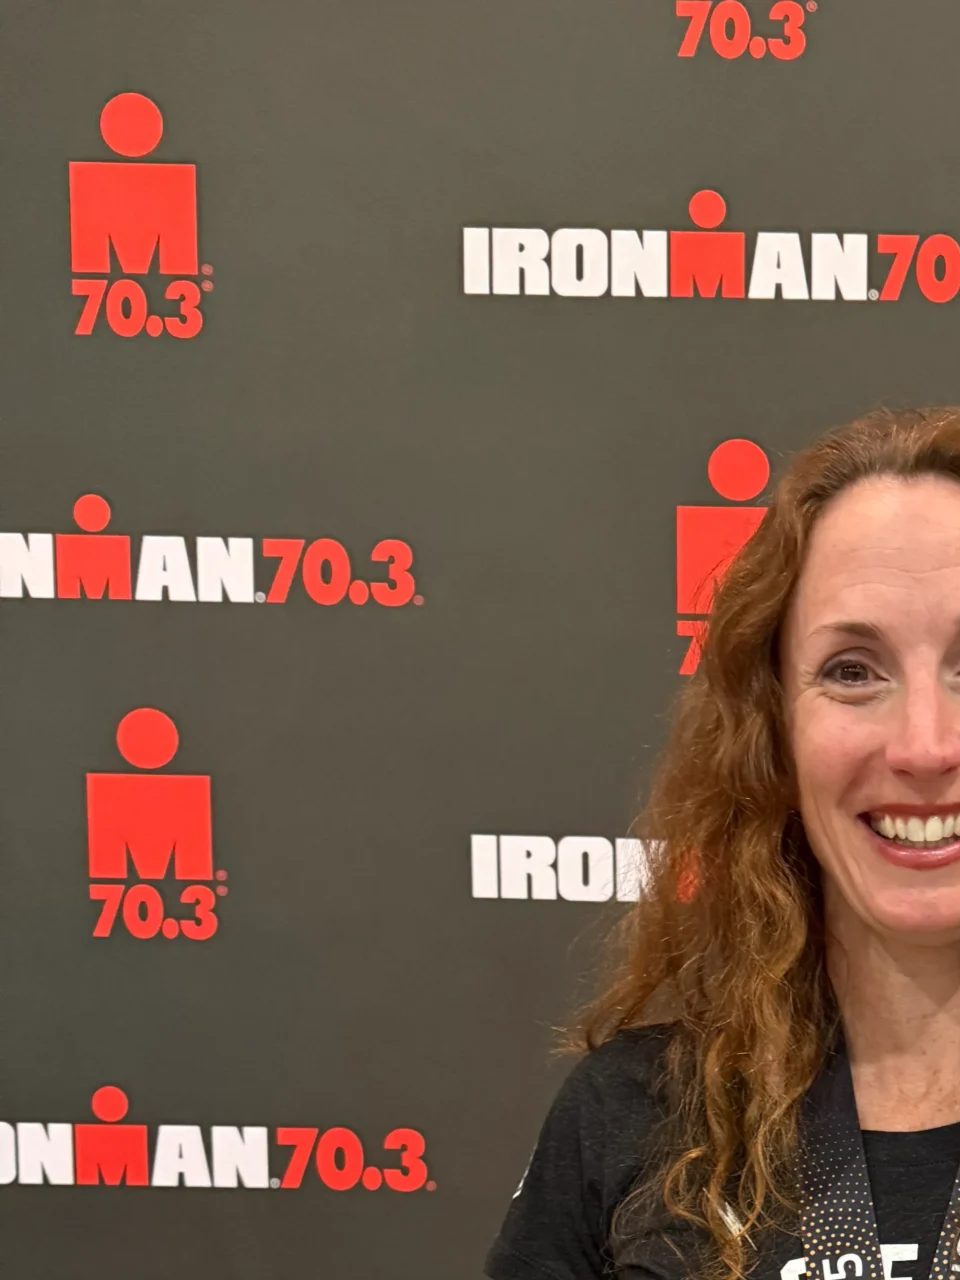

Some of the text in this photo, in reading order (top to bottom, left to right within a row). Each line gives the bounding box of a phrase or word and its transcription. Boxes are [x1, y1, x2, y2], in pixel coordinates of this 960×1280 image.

[676, 0, 806, 61] 70.3
[72, 280, 203, 339] 70.3
[262, 539, 415, 608] 70.3
[471, 835, 700, 903] IRON
[90, 885, 218, 940] 70.3
[0, 1122, 428, 1193] NMAN 70.3
